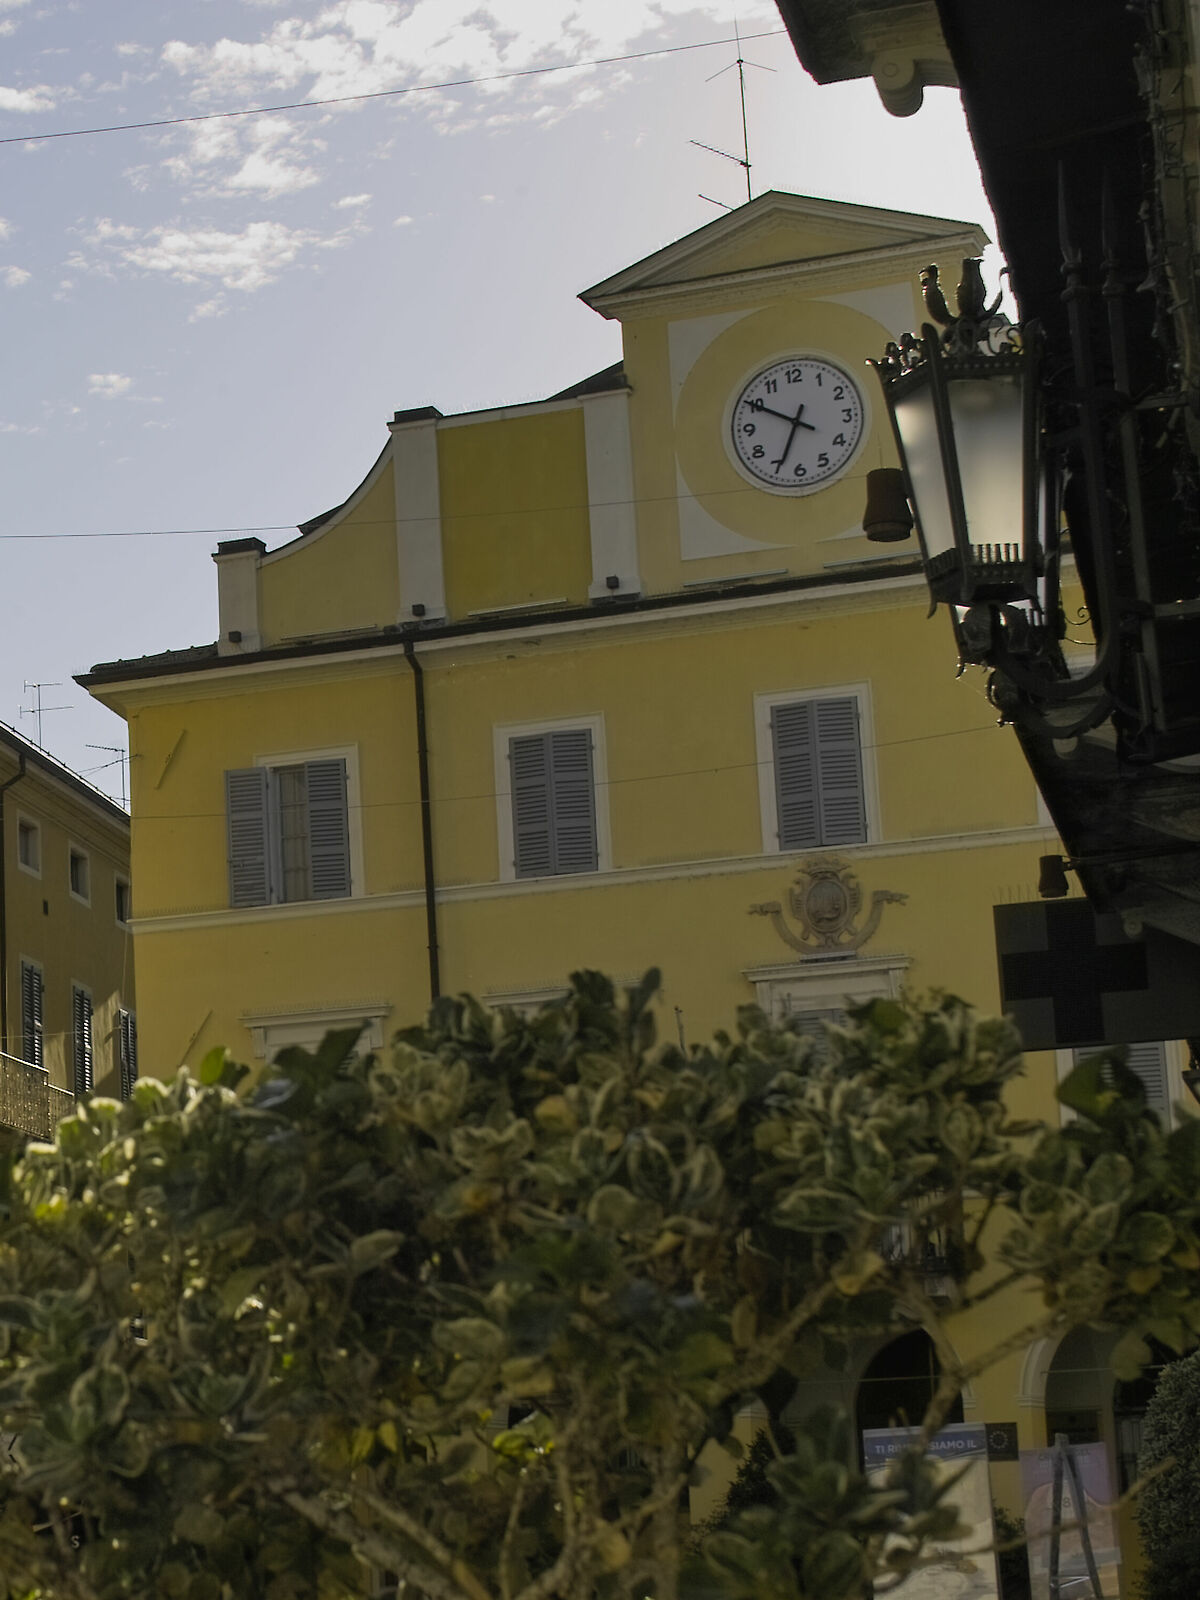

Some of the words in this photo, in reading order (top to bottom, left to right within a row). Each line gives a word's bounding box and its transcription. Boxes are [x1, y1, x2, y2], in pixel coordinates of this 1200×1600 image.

[784, 368, 803, 384] 12
[815, 373, 822, 386] 1
[764, 379, 778, 393] 11
[833, 386, 844, 400] 2
[750, 398, 764, 413] 10
[841, 408, 852, 423] 3
[743, 423, 755, 437] 9
[832, 433, 846, 447] 4
[752, 445, 765, 458] 8
[771, 459, 783, 473] 7
[818, 453, 829, 467] 5
[794, 464, 807, 477] 6
[875, 1445, 886, 1455] TI
[887, 1439, 965, 1455] RISIAMO
[967, 1439, 977, 1449] IL
